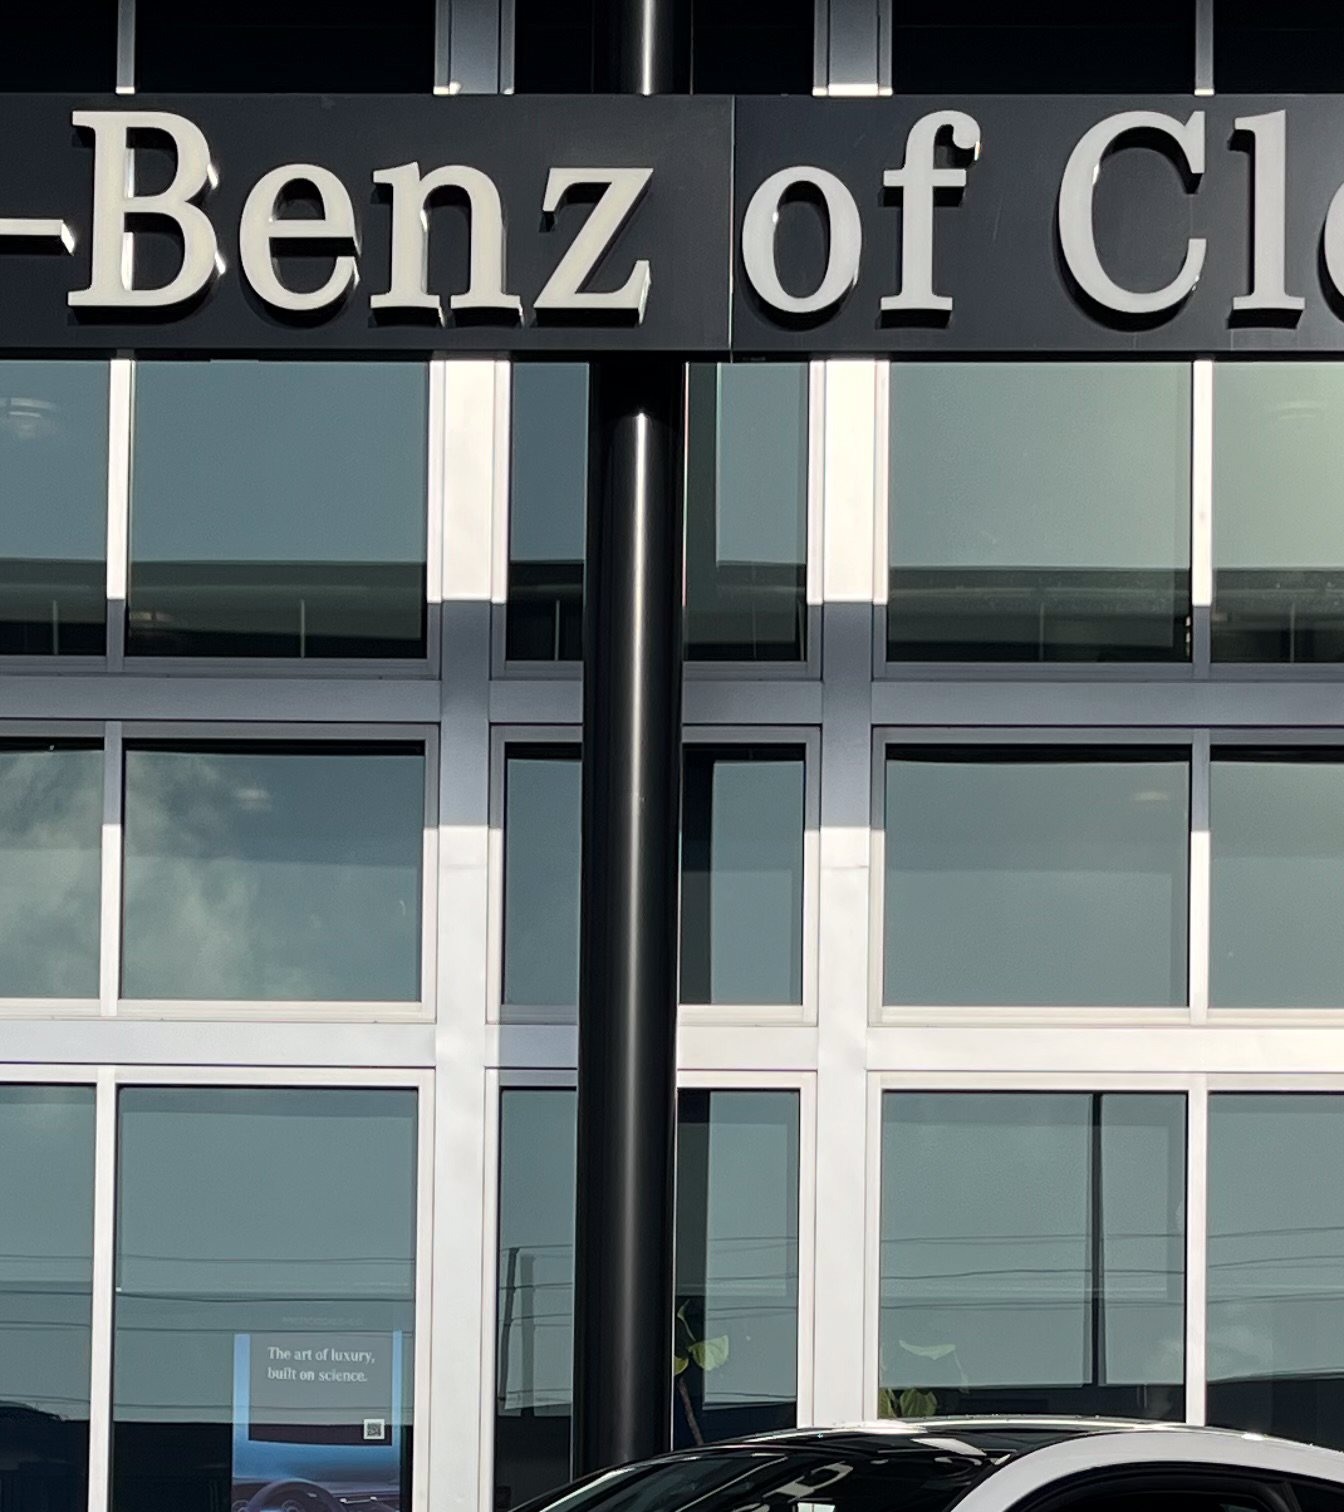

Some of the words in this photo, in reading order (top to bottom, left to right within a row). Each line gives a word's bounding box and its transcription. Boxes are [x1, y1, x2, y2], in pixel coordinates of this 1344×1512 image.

[740, 109, 982, 315] of
[267, 1346, 292, 1361] The
[294, 1347, 312, 1361] art
[315, 1348, 330, 1361] of
[331, 1348, 376, 1364] luxury,
[267, 1366, 296, 1381] built
[299, 1370, 315, 1382] on
[318, 1367, 369, 1382] science.
